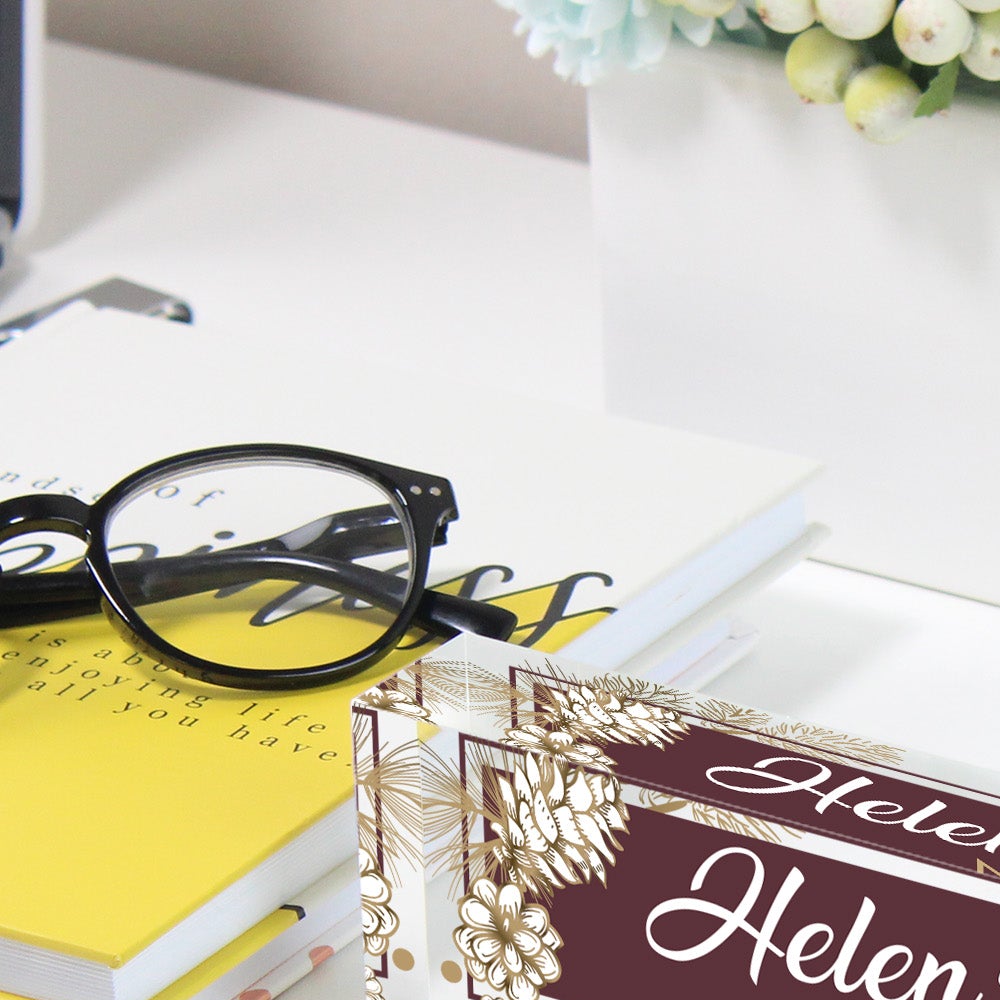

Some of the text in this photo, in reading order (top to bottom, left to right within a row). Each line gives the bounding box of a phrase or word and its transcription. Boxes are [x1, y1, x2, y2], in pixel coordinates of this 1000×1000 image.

[155, 484, 225, 507] of
[27, 629, 67, 648] is
[1, 650, 327, 734] enjoying life
[27, 680, 352, 767] all you have.
